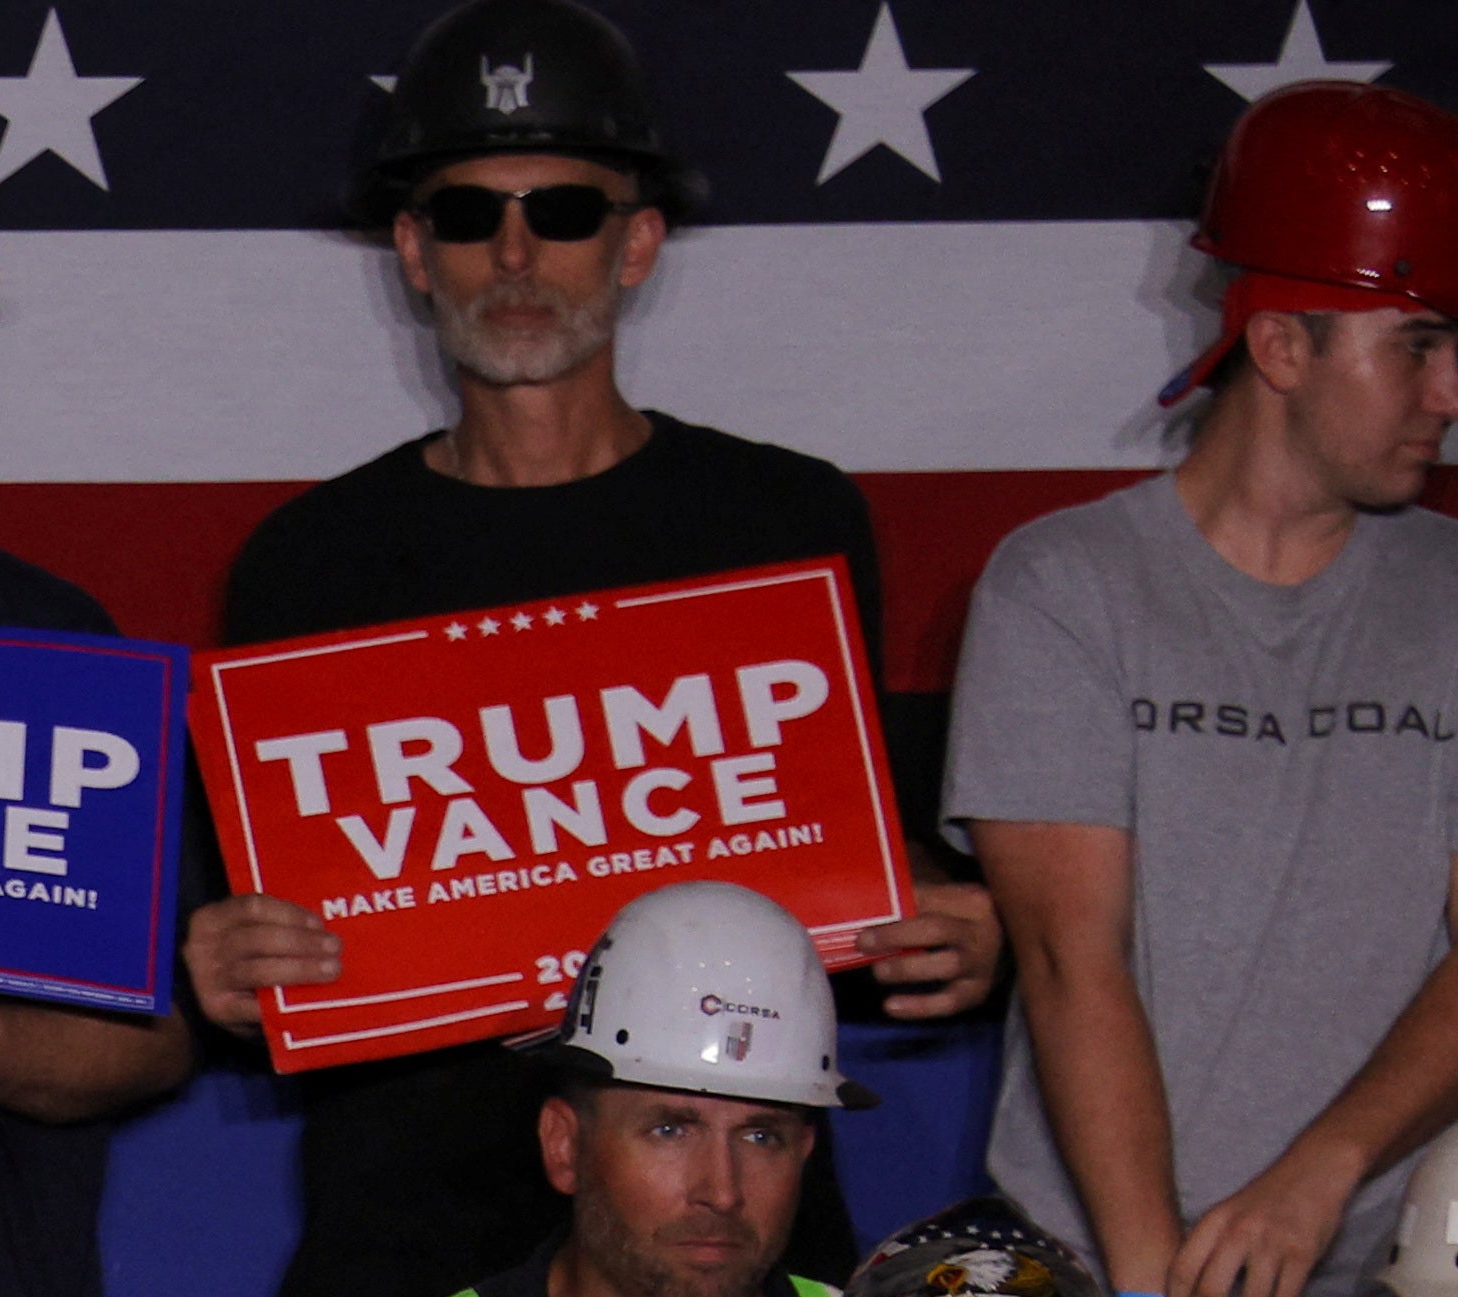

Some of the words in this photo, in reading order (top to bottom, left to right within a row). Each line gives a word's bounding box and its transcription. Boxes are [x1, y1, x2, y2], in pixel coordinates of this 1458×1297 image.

[256, 659, 830, 818] TRUMP
[1131, 697, 1286, 746] ORSA
[336, 752, 788, 880] VANCE
[322, 889, 416, 921] MAKE
[427, 861, 578, 903] AMERICA
[587, 842, 695, 879] GREAT
[708, 822, 824, 859] AGAIN!
[725, 1003, 781, 1020] CORSA
